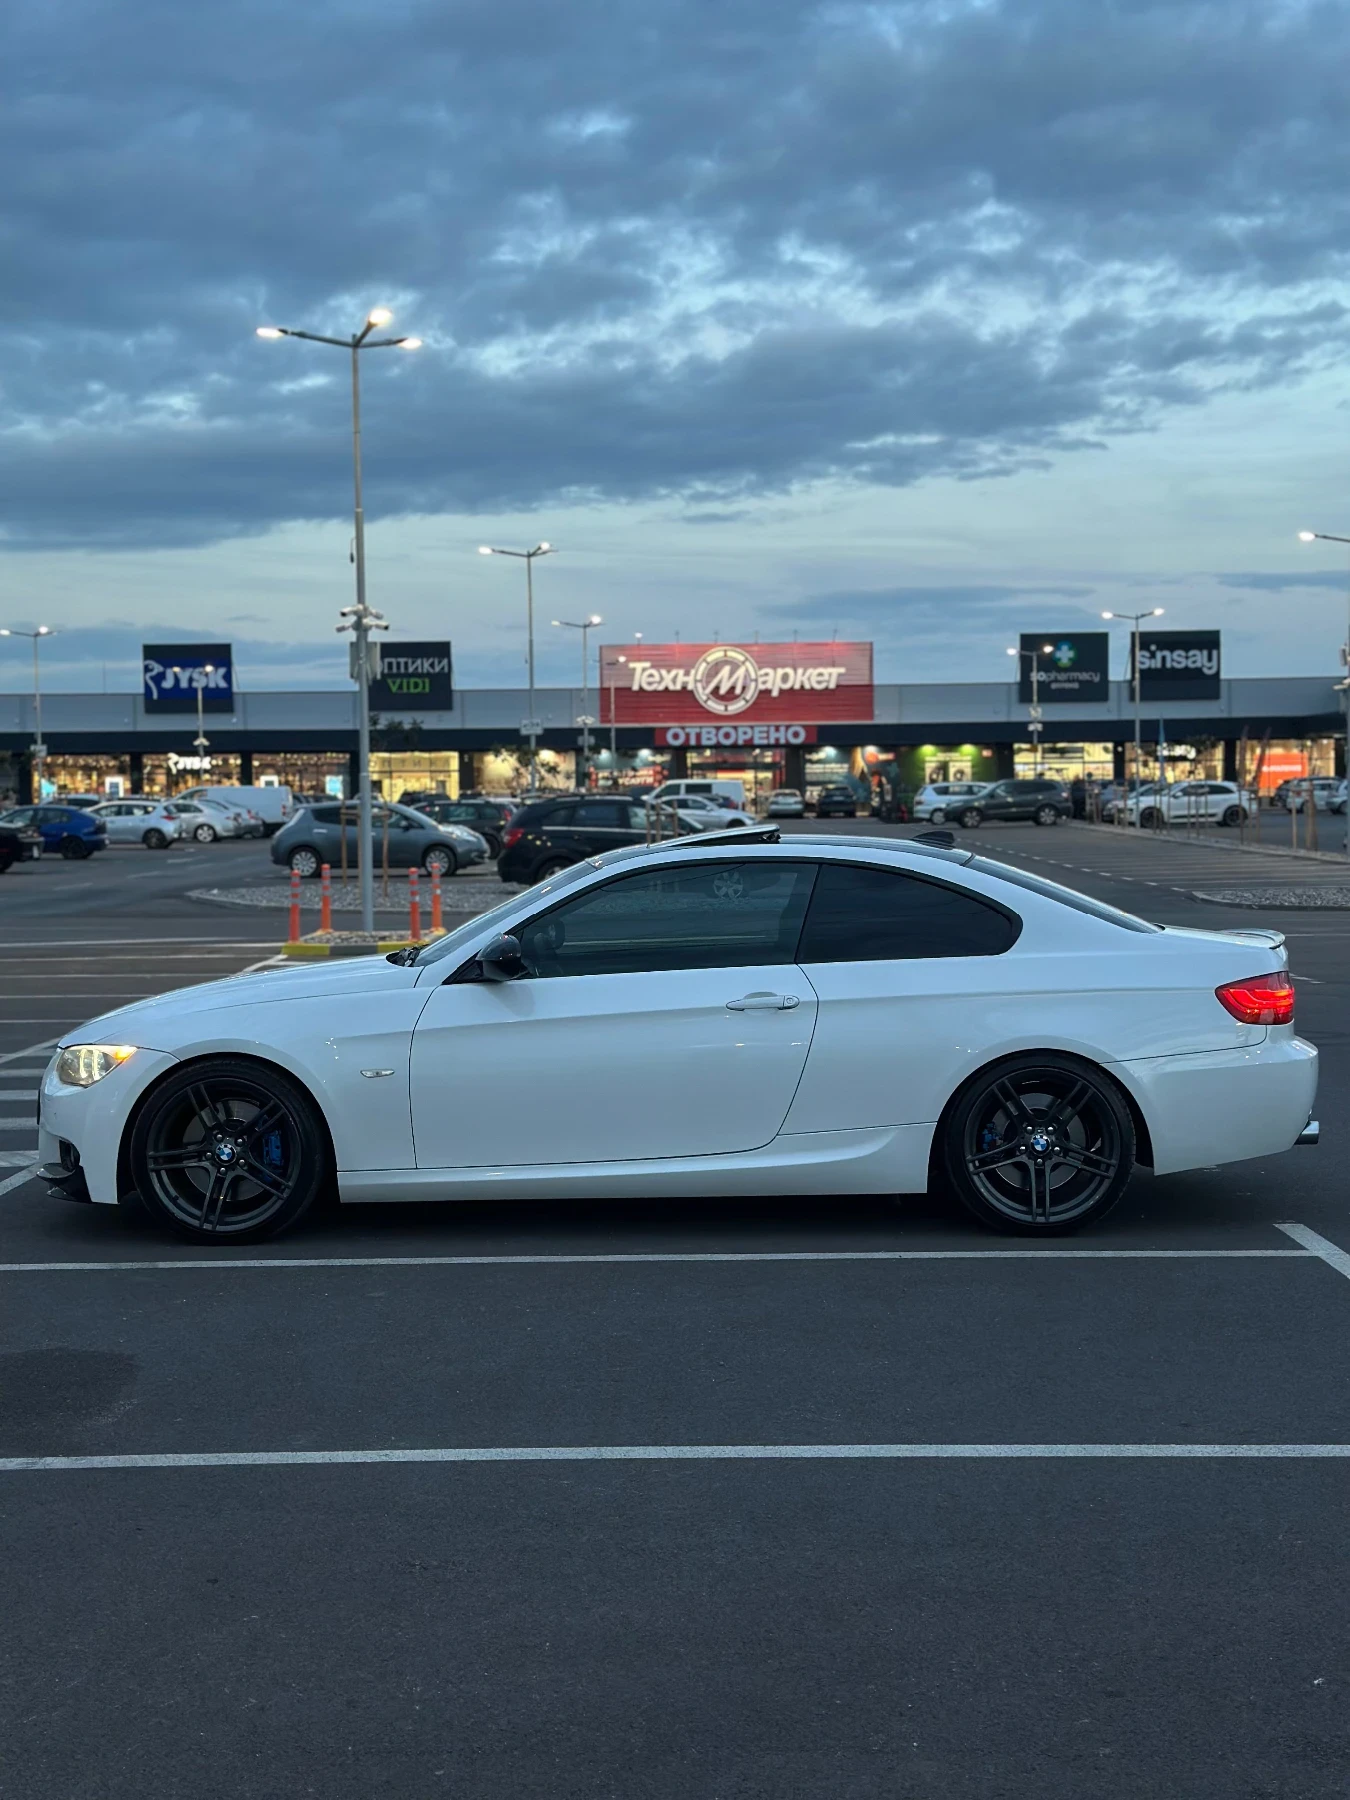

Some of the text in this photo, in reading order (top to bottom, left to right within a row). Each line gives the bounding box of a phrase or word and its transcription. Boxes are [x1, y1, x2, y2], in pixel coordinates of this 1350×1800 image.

[380, 657, 449, 674] ПТИКИ
[1137, 644, 1219, 675] sinsay
[162, 667, 228, 689] JYSK
[387, 678, 431, 694] VIDI
[666, 725, 806, 746] ОТВОРЕНО
[178, 757, 212, 769] JYSK
